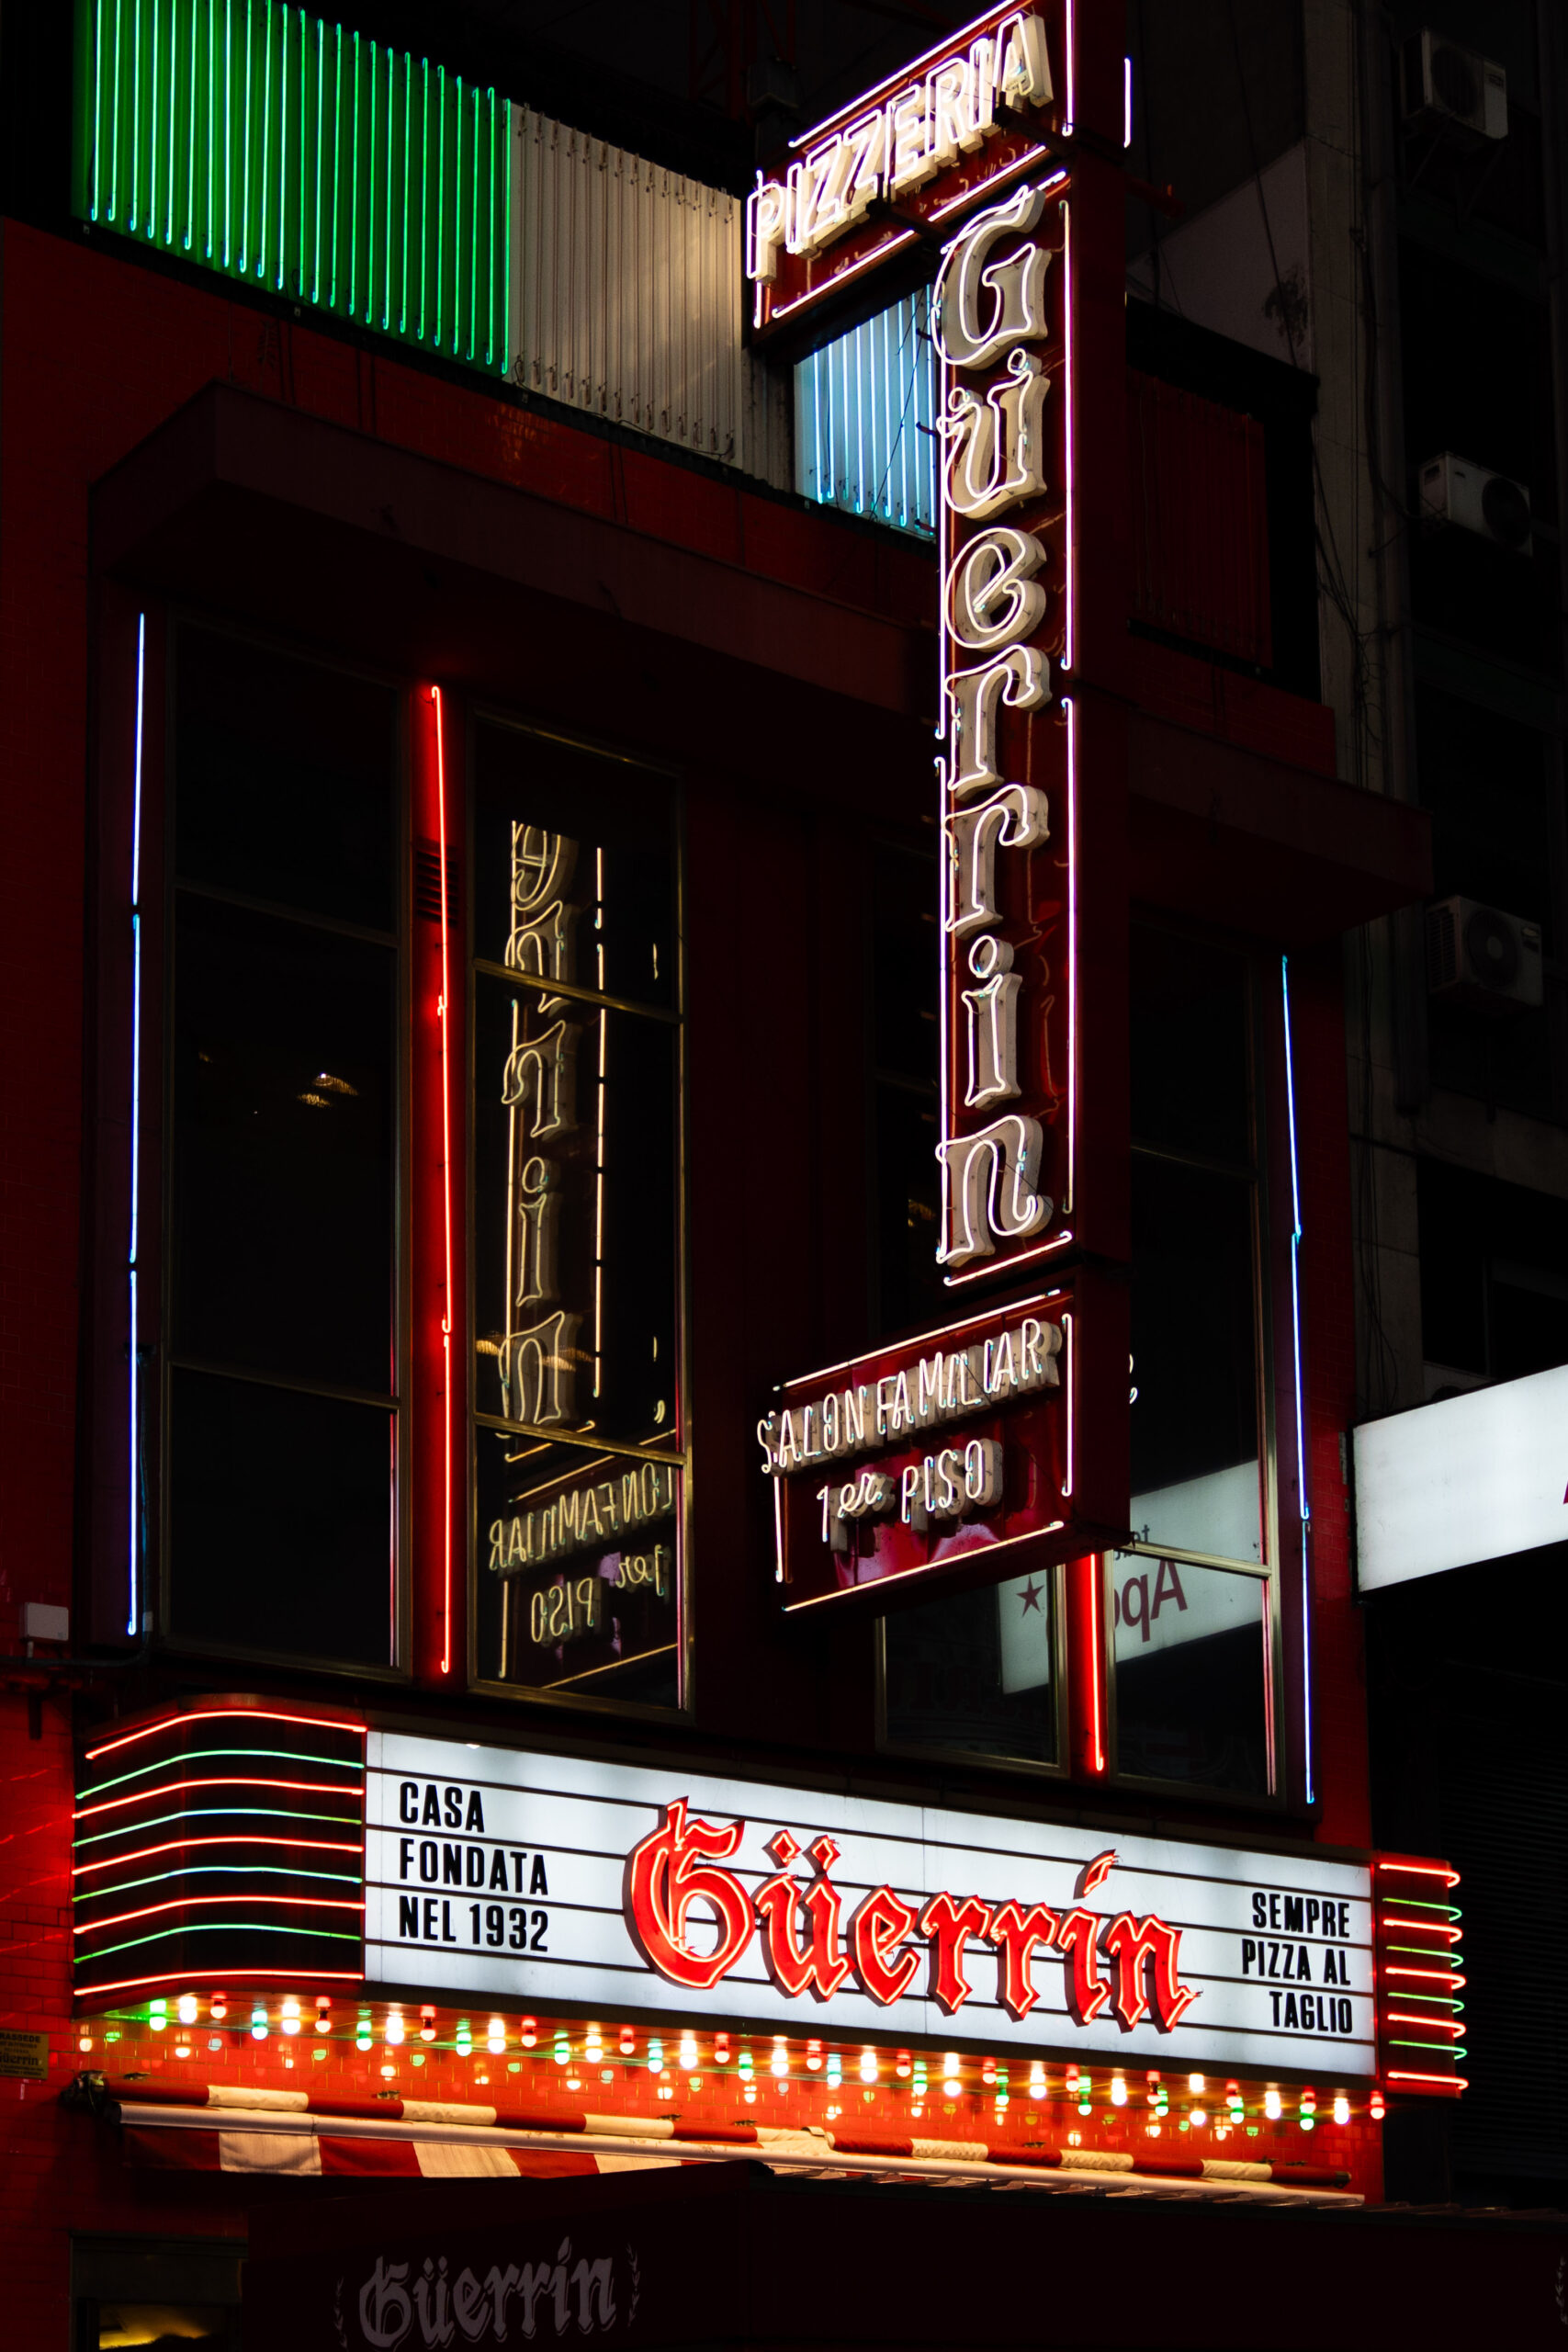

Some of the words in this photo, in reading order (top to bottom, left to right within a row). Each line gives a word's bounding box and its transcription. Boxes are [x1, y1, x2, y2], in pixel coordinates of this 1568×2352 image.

[747, 12, 1053, 285] PIZZERIA
[756, 1382, 885, 1476] SALON
[876, 1317, 1062, 1442] FAMILIAR
[817, 1472, 896, 1553] 1er
[901, 1438, 1003, 1533] PISO
[399, 1781, 485, 1834] CASA
[399, 1837, 549, 1896] FONDATA
[398, 1894, 457, 1943] NEL
[468, 1903, 549, 1953] 1932
[1251, 1891, 1351, 1939] SEMPRE
[1240, 1937, 1313, 1983] PIZZA
[1323, 1947, 1352, 1987] AL
[1268, 1990, 1354, 2035] TAGLIO
